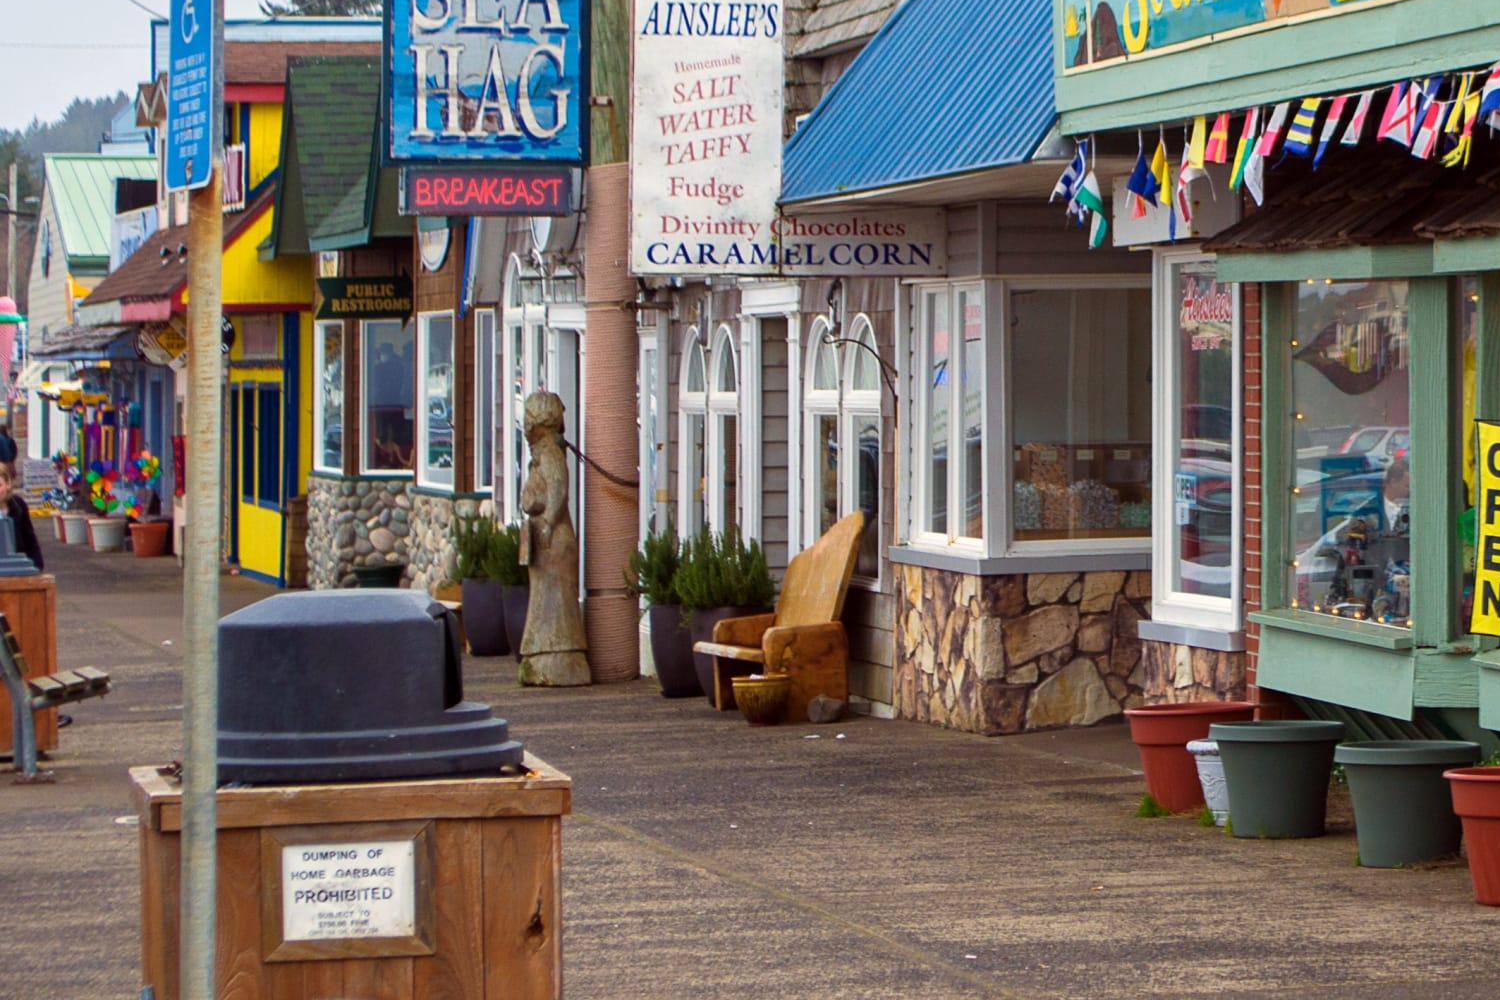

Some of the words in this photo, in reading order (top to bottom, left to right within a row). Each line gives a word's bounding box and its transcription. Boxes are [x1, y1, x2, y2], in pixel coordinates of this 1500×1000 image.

[641, 0, 779, 38] AINSLEE'S
[674, 53, 742, 74] Homemade
[409, 36, 571, 142] HAG
[672, 74, 742, 105] SALT
[656, 103, 758, 137] WATER
[660, 133, 752, 166] TAFFY
[415, 178, 563, 206] BREAKFAST
[668, 176, 745, 206] Fudge
[659, 215, 761, 242] Divinity
[769, 217, 907, 238] Chocolates
[346, 284, 394, 298] PUBLIC
[331, 298, 411, 313] RESTROOMS
[302, 849, 358, 862] DUMPING
[367, 848, 383, 860] OF
[291, 869, 326, 881] HOME
[335, 866, 395, 879] GARBAGE
[294, 886, 392, 904] PROHIBITED
